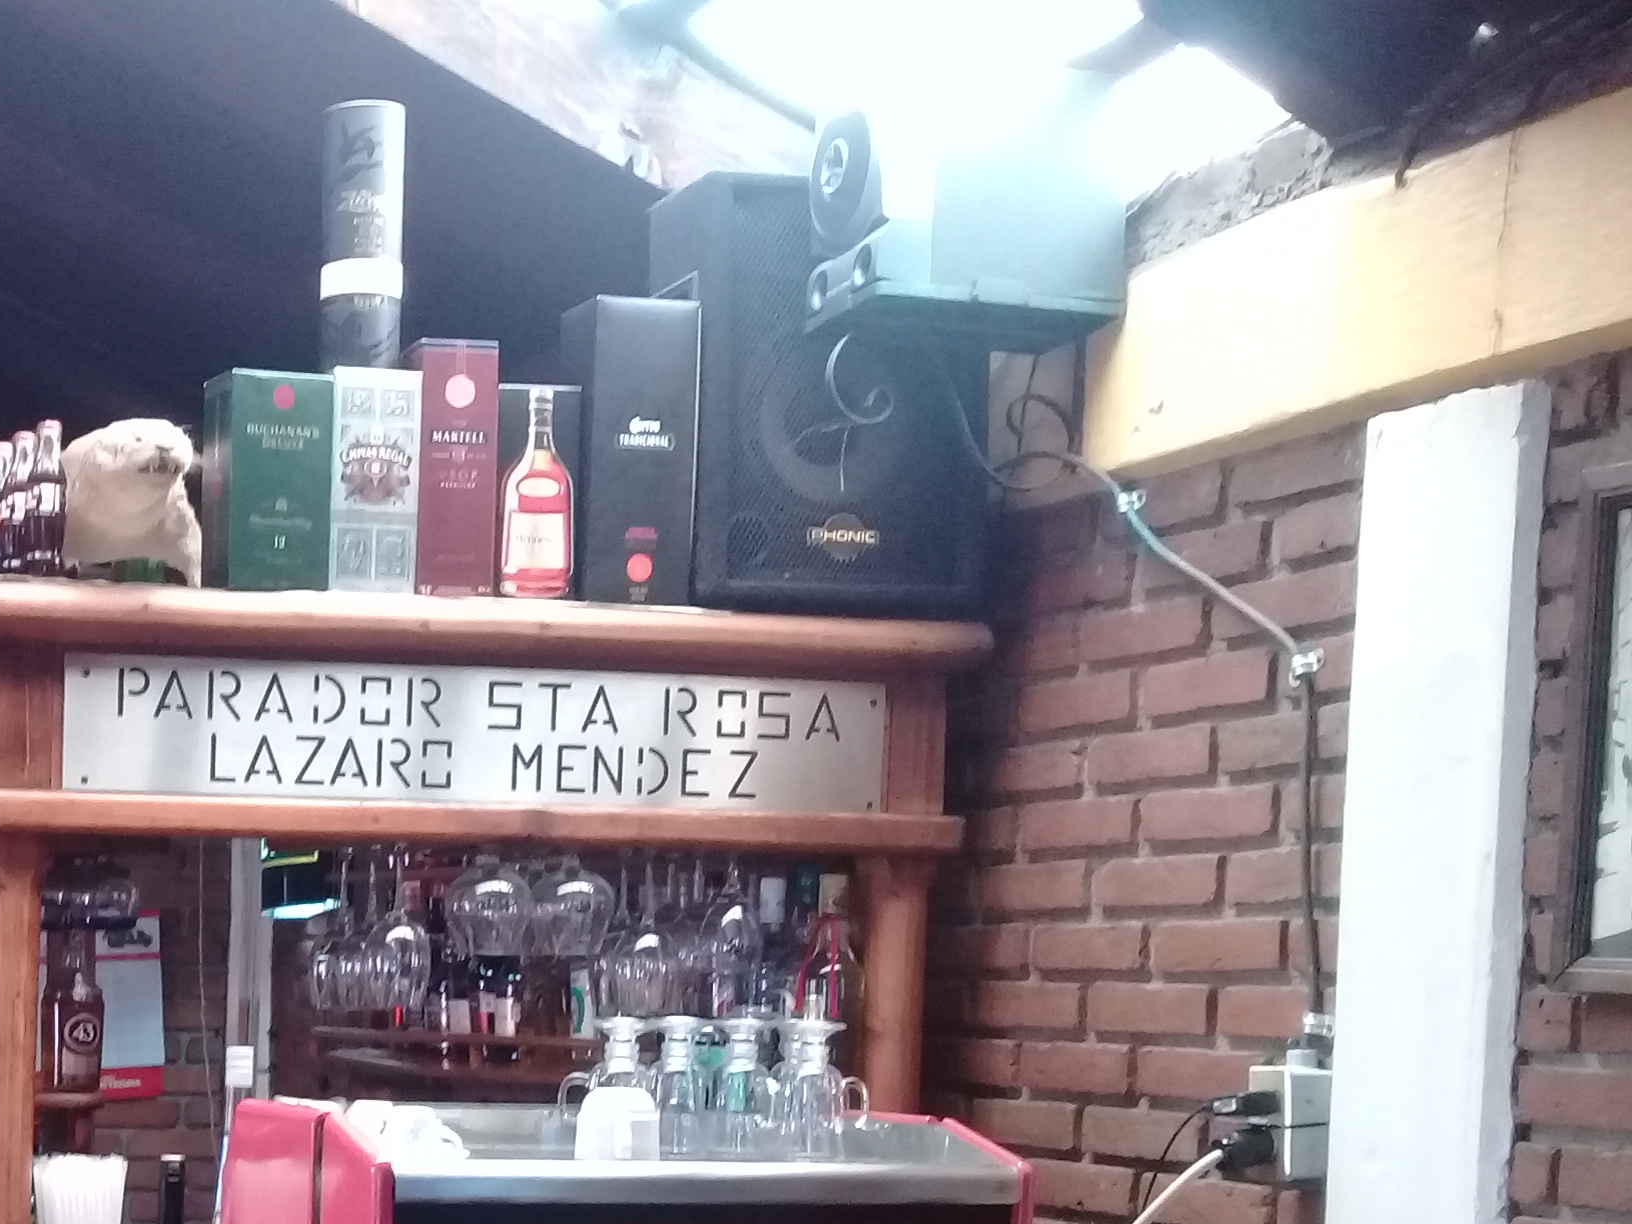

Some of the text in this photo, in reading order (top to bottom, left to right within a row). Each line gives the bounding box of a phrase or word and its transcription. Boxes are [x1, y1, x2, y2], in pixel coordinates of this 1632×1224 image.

[431, 430, 486, 444] MARTELL
[619, 433, 669, 447] TRADICIONAL
[809, 528, 877, 544] PHONIC
[117, 665, 842, 743] PARADOR STA ROSA
[208, 733, 759, 800] LAZARO MENDEZ
